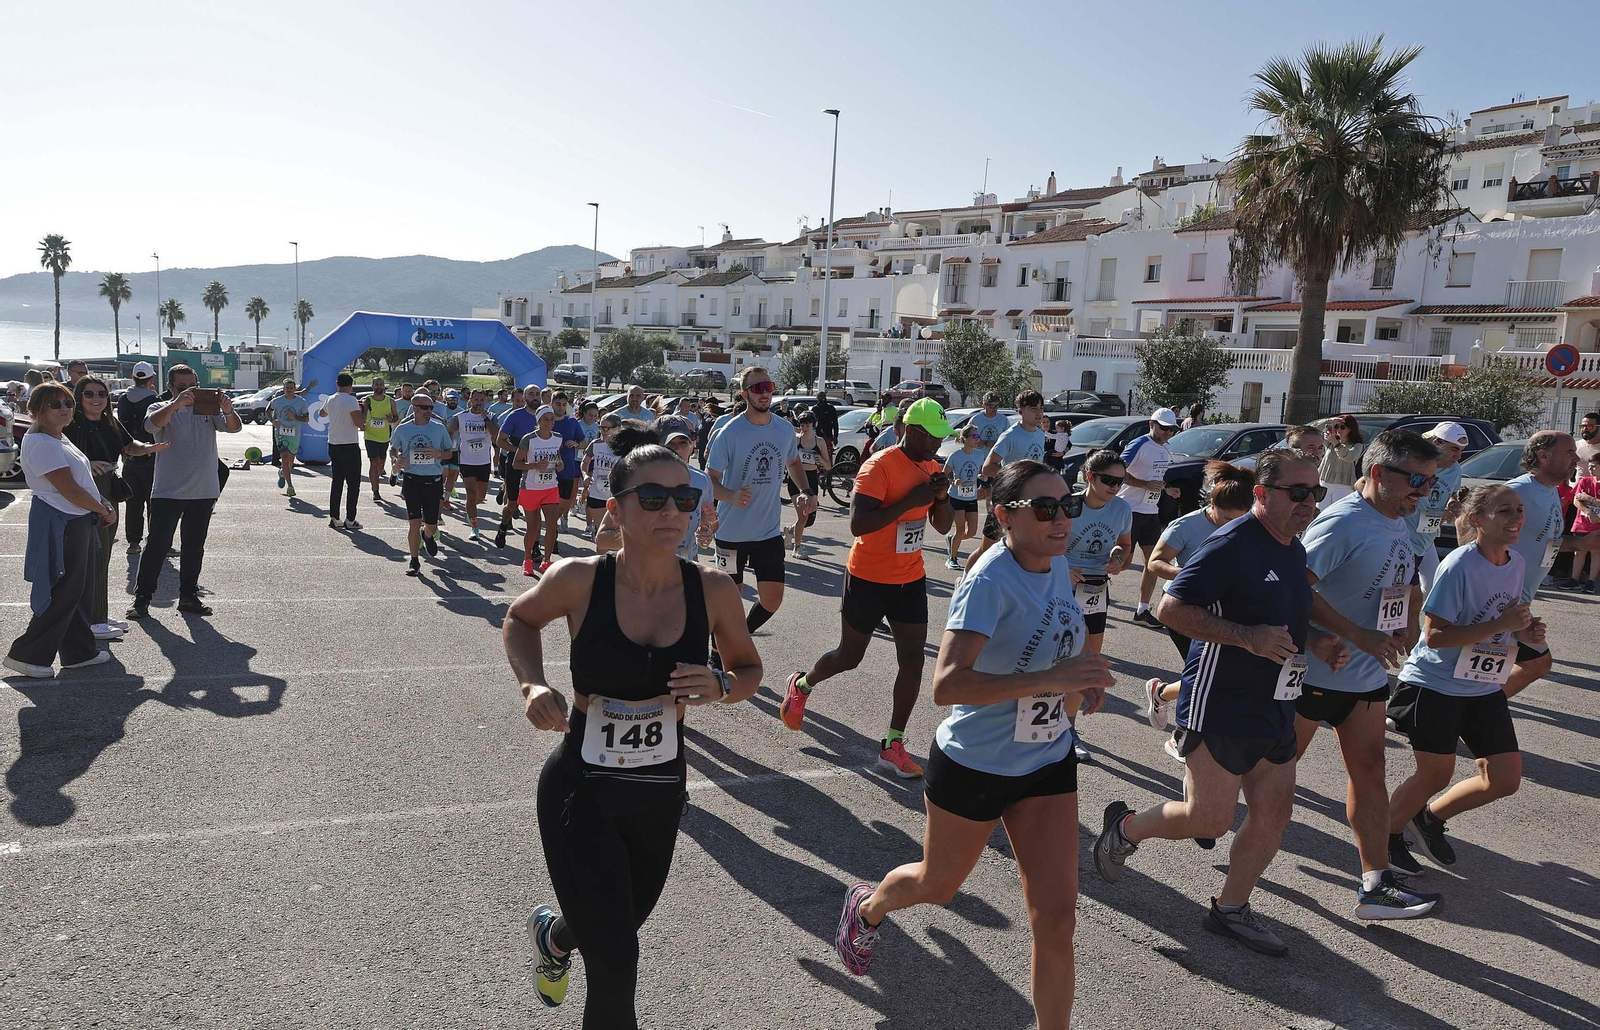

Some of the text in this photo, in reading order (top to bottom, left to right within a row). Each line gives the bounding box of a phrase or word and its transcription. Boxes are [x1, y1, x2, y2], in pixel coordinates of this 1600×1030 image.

[410, 318, 454, 327] META
[411, 331, 436, 346] CHIP
[418, 328, 455, 342] DORSAL
[1098, 522, 1114, 535] CIUDAD
[1428, 518, 1440, 527] 36
[904, 529, 923, 544] 273
[1363, 586, 1375, 600] XXIV
[1373, 559, 1392, 586] CARRERA
[1086, 595, 1099, 606] 48
[1484, 592, 1501, 610] URBANA
[1382, 600, 1404, 619] 160
[1018, 628, 1045, 667] CARRERA
[1056, 597, 1080, 615] CIUDAD
[1470, 655, 1506, 673] 161
[603, 710, 624, 720] CIUDAD
[634, 709, 664, 720] ALGECIRAS
[635, 702, 663, 713] URBANA
[601, 721, 663, 749] 148
